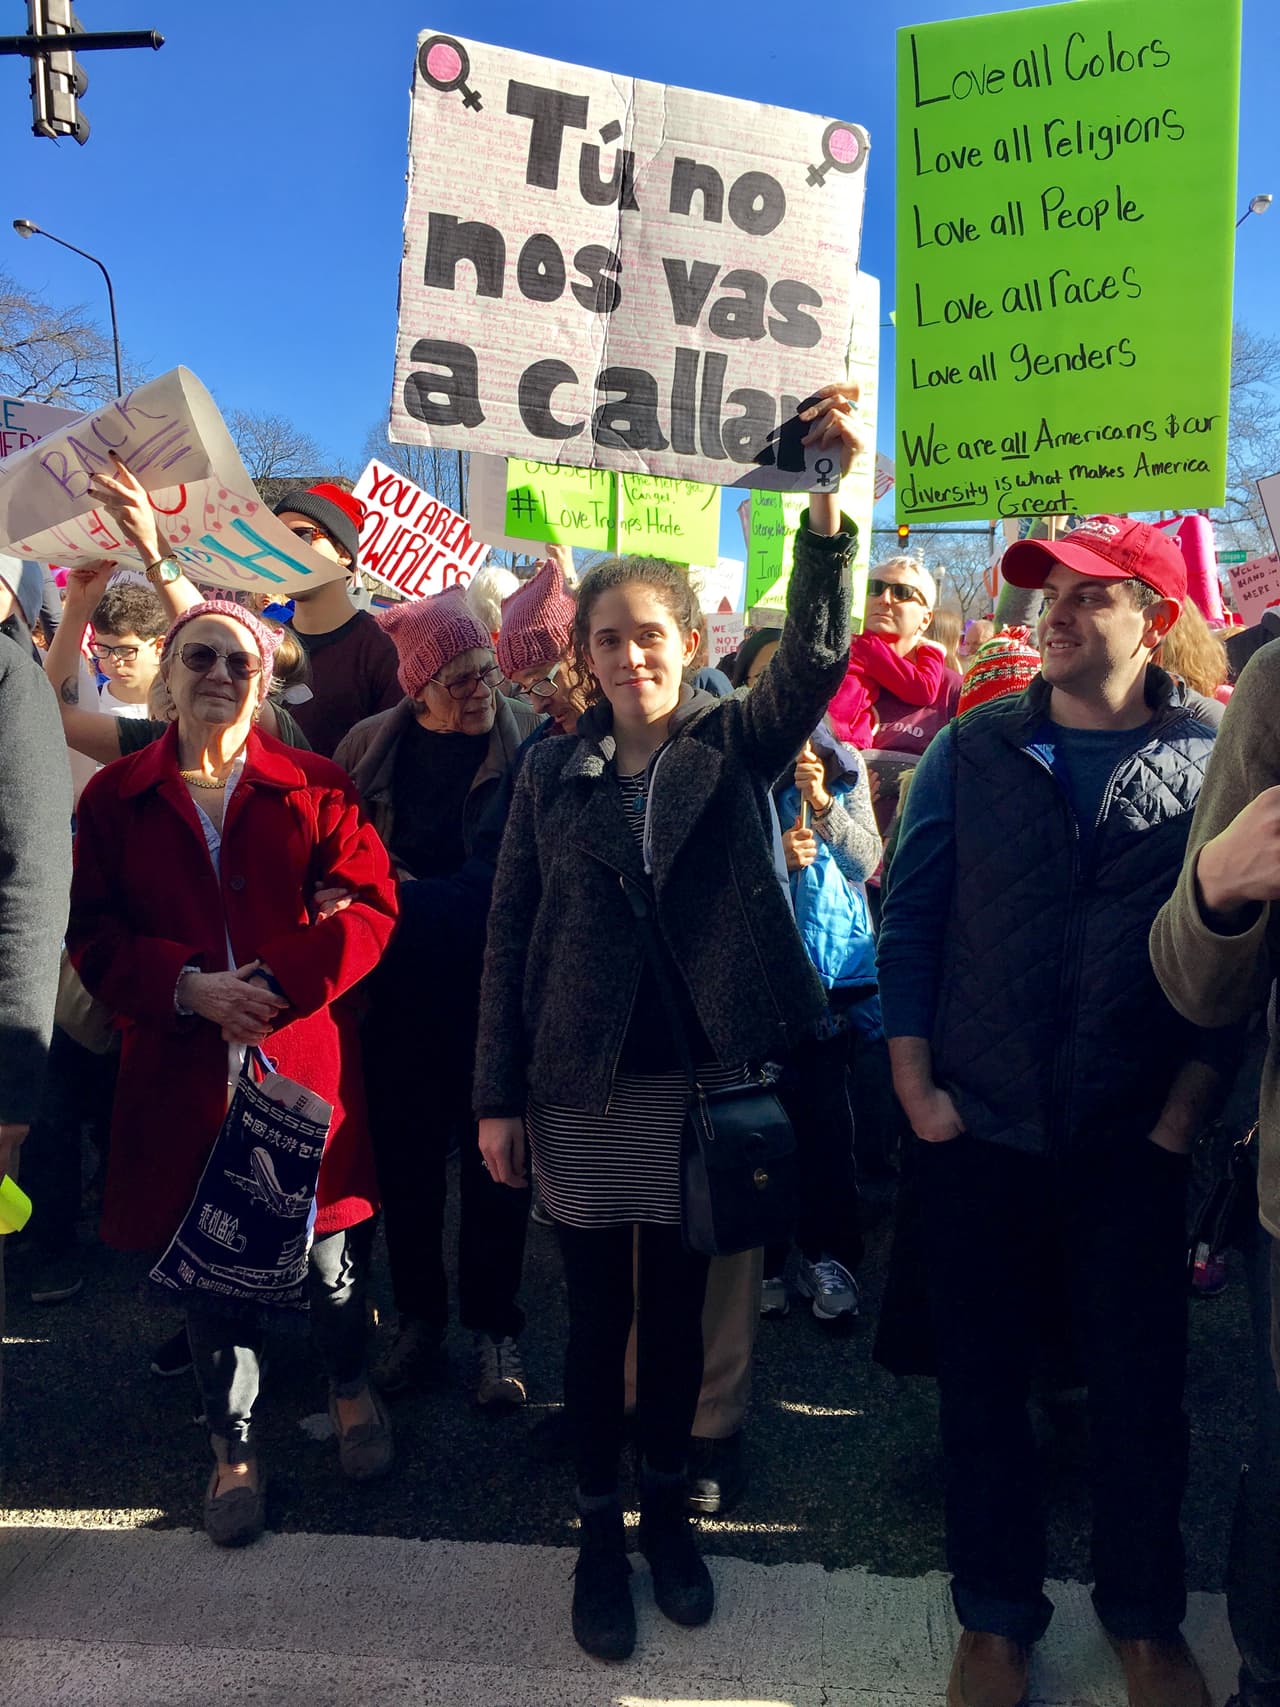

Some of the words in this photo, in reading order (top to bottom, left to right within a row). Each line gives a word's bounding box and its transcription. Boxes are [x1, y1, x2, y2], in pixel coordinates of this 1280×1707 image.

[911, 34, 1005, 108] Love
[1012, 43, 1052, 88] all
[1065, 31, 1170, 82] Colors
[506, 79, 639, 211] Tú
[669, 156, 786, 236] no
[914, 127, 983, 176] Love
[993, 125, 1032, 163] all
[1044, 108, 1185, 161] religions
[914, 204, 981, 249] Love
[990, 201, 1024, 236] all
[1041, 185, 1144, 231] People
[424, 211, 623, 314] nos
[662, 258, 823, 348] vas
[915, 283, 993, 327] Love
[1001, 279, 1043, 314] all
[1050, 266, 1142, 309] races
[403, 338, 486, 429] a
[912, 358, 964, 389] Love
[969, 352, 997, 383] all
[1009, 337, 1136, 382] genders
[41, 391, 167, 501] BACK
[901, 422, 950, 467] We
[957, 438, 997, 459] are
[1000, 431, 1028, 455] all
[1034, 417, 1157, 452] Americans
[367, 465, 421, 518] YOU
[901, 473, 988, 508] diversity
[995, 477, 1011, 494] is
[1015, 470, 1063, 488] what
[1133, 451, 1210, 478] America
[997, 490, 1078, 517] Great.
[712, 624, 726, 633] WE
[716, 636, 738, 645] NOT
[893, 721, 924, 738] DAD
